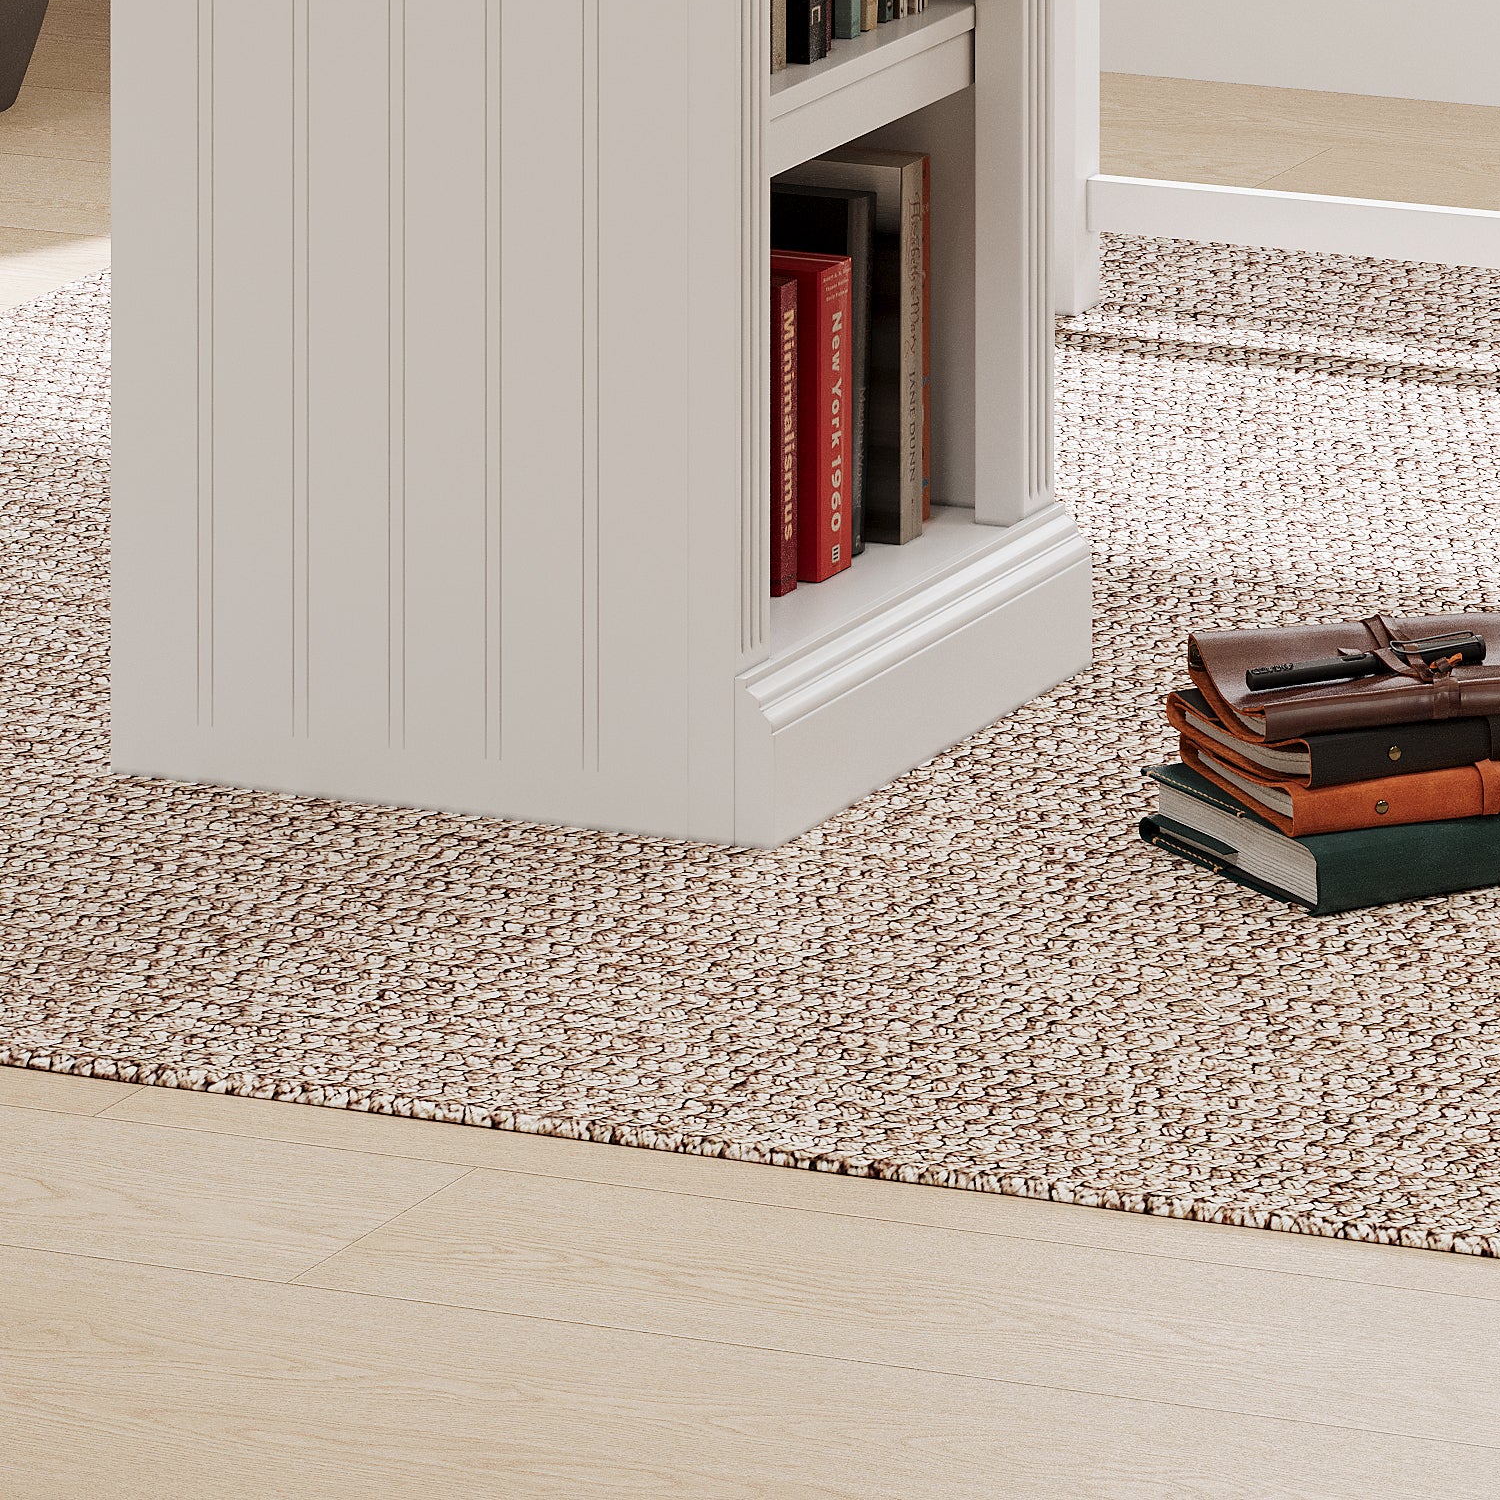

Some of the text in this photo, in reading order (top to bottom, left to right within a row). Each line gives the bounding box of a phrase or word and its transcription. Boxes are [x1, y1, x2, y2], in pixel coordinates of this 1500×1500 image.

[831, 311, 842, 371] New
[783, 308, 795, 542] Minimalismus
[831, 377, 842, 449] York
[908, 370, 916, 483] JANE DUNN
[831, 454, 842, 532] 1960
